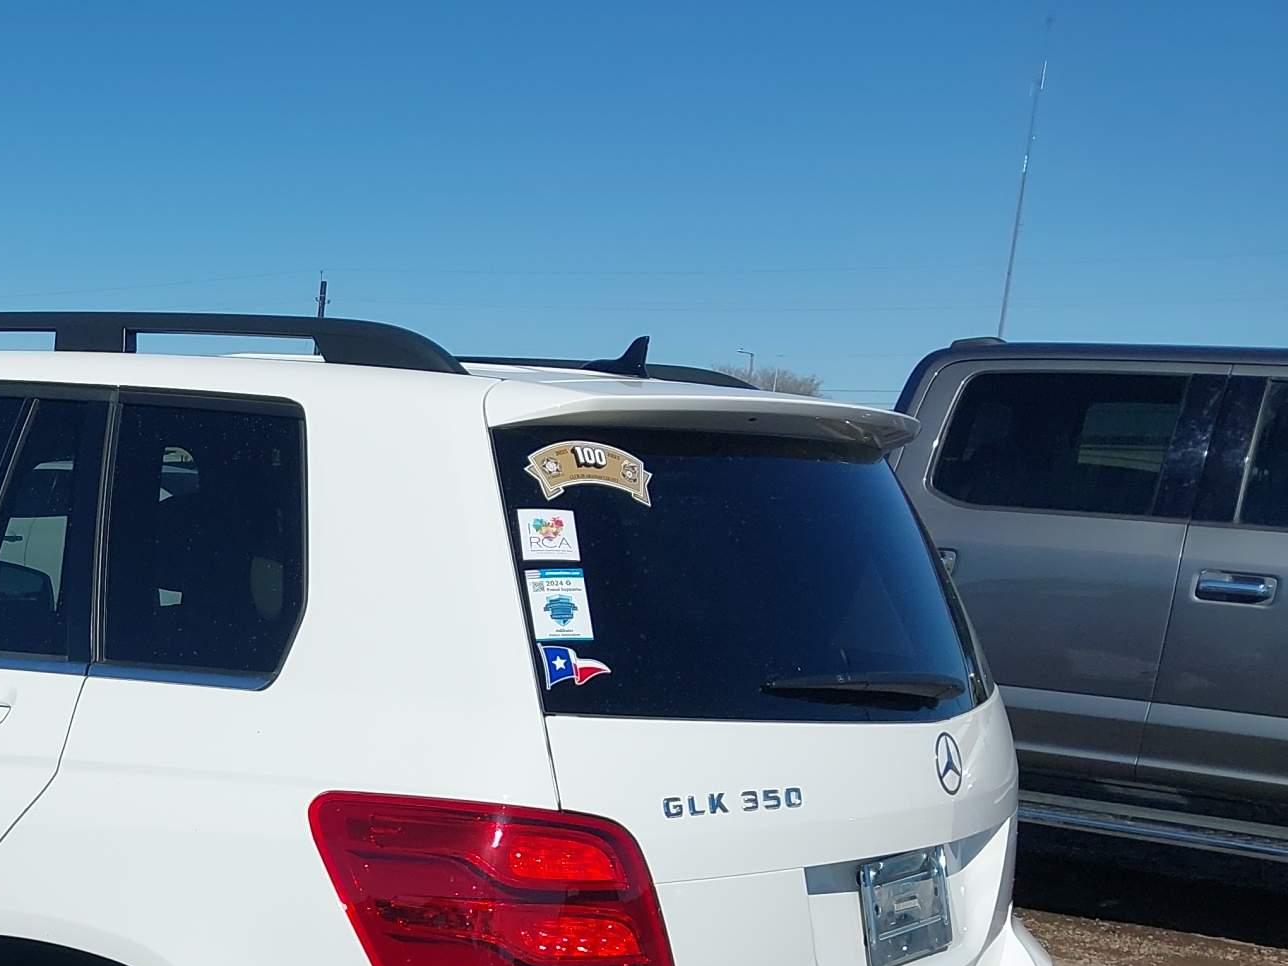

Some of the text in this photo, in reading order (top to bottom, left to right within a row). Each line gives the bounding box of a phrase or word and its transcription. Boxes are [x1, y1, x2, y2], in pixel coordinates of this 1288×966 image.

[572, 446, 607, 468] 100
[529, 536, 572, 549] RCA
[663, 787, 802, 818] GLK 350
